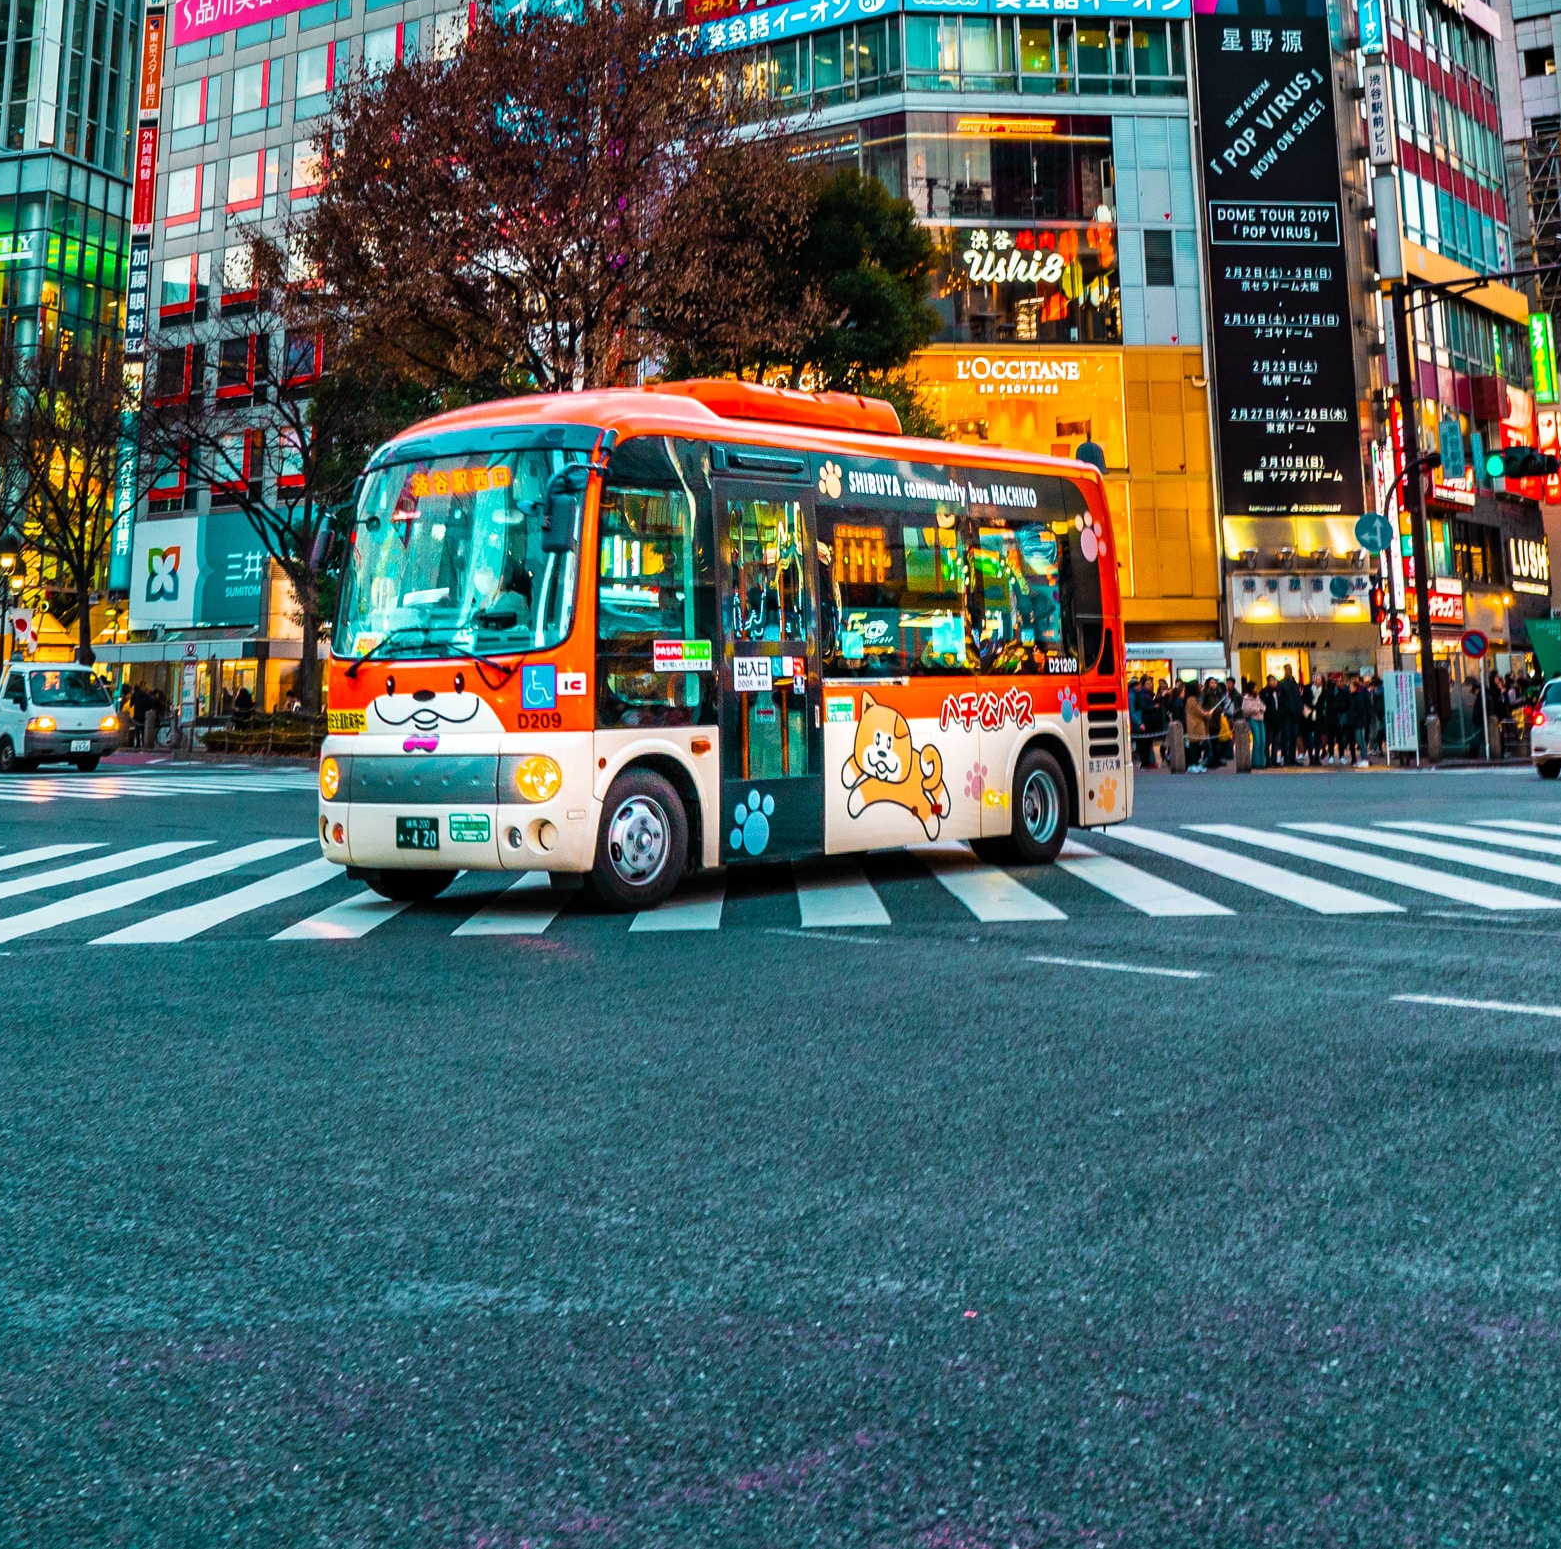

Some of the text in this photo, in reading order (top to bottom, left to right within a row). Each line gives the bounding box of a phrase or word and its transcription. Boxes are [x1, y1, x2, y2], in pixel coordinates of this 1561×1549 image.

[1221, 28, 1304, 53] 星野源
[145, 29, 161, 106] 東京スター銀行
[1224, 78, 1271, 128] NEW ALBUM
[1368, 73, 1387, 157] 渋谷駅前ビル
[1250, 98, 1326, 180] NOW ON SALE!
[140, 130, 154, 180] 外貨両替
[1217, 207, 1330, 223] DOME TOUR 2019
[970, 228, 1013, 250] 渋谷
[962, 250, 1065, 283] Ushi8
[127, 249, 148, 332] 加藤眼科
[1241, 281, 1320, 292] 京セラドーム大阪
[1254, 327, 1313, 339] ナゴヤドーム
[956, 357, 1080, 381] L'OCCITANE
[1262, 374, 1312, 386] 札幌ドーム
[1265, 422, 1316, 434] 東京ドーム
[848, 471, 1038, 508] SHIBUYA community bus HACHIKO
[1510, 537, 1550, 581] LUSH
[655, 646, 709, 657] PASMO Suica
[737, 660, 769, 677] 出入口
[1048, 657, 1078, 674] D21209
[518, 712, 562, 730] D209
[940, 687, 1035, 732] ハチ公バス
[1088, 759, 1121, 773] 京王バス東
